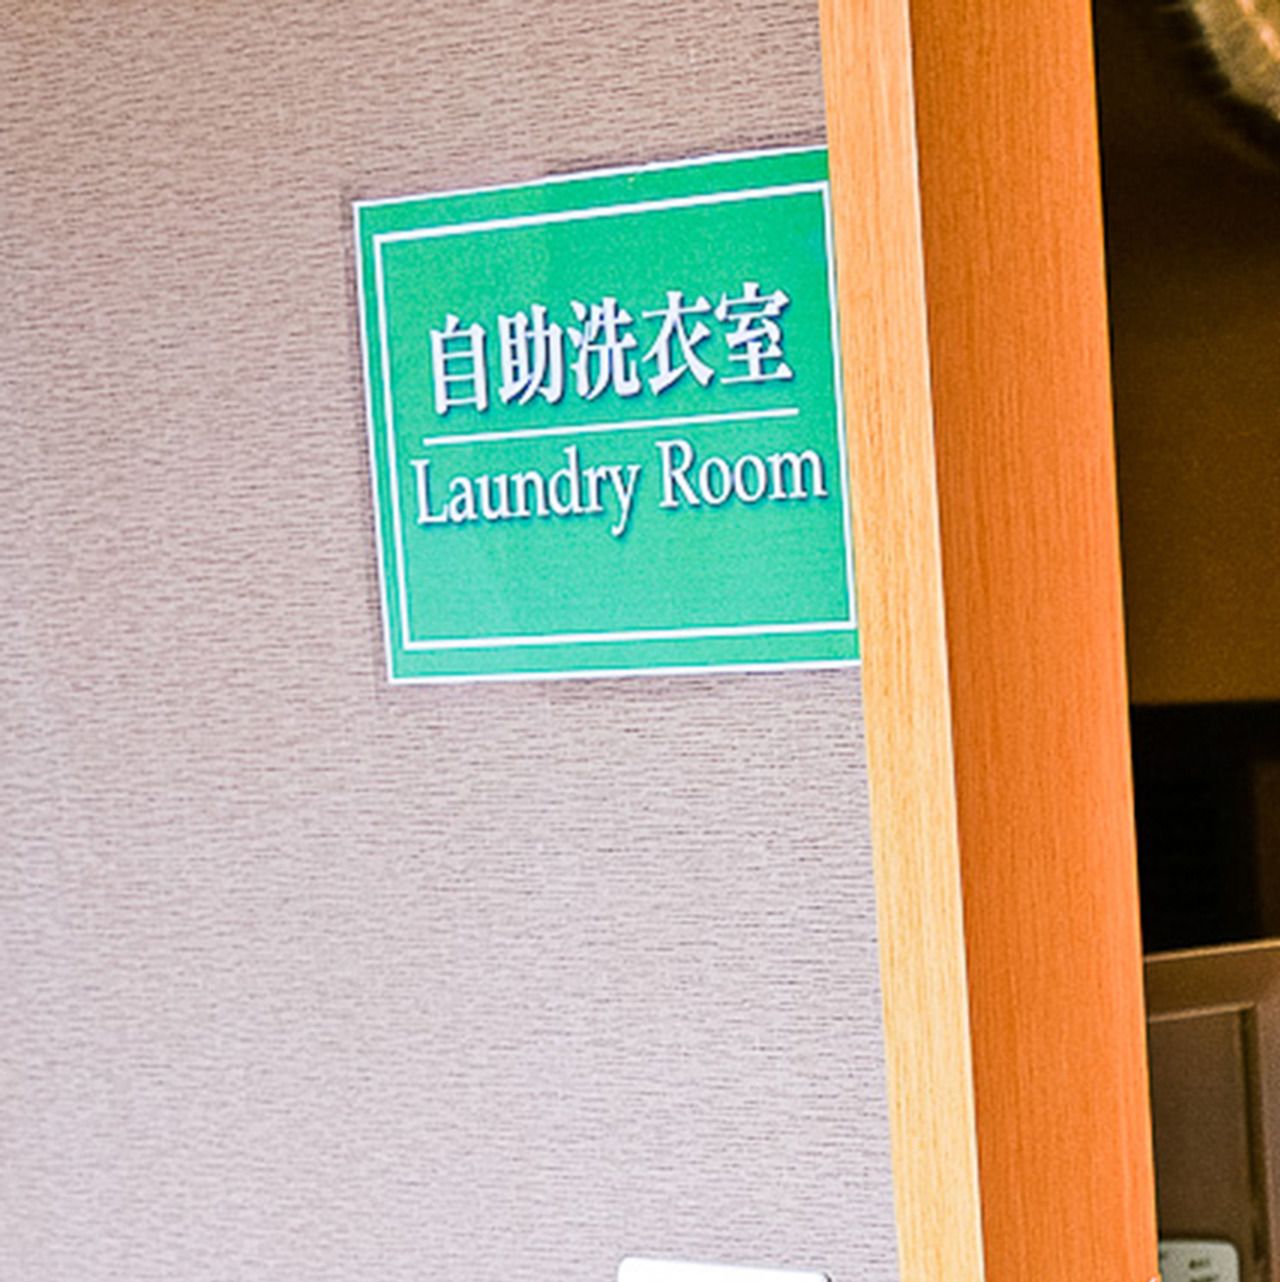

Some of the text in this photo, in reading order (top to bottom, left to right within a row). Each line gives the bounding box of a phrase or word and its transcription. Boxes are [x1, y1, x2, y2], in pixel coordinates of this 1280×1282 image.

[429, 282, 794, 415] 自助洗衣室
[411, 438, 827, 536] Laundry Room
